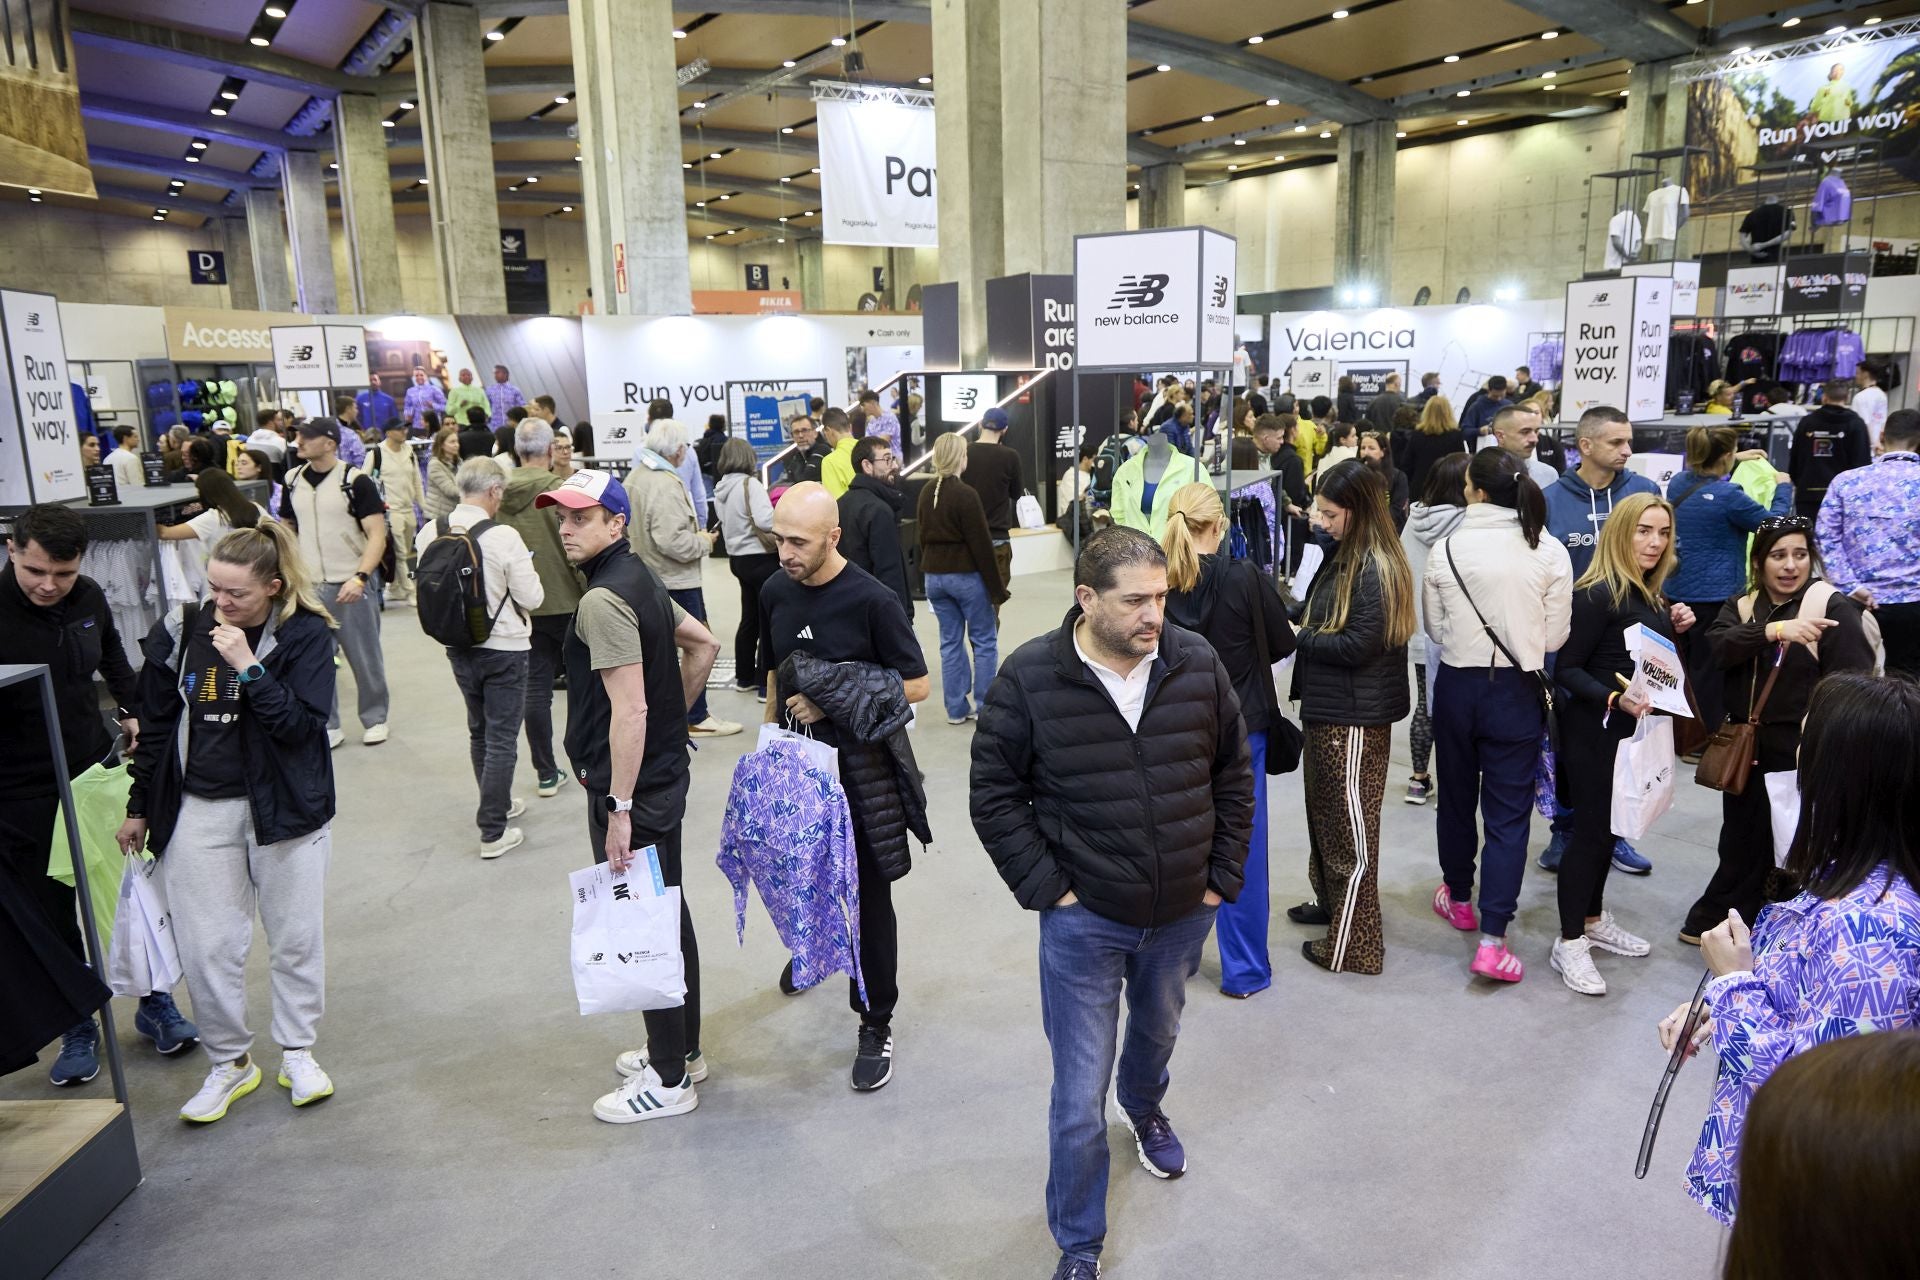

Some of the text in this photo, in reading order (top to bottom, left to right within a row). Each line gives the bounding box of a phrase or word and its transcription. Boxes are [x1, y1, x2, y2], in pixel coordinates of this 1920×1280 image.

[1759, 110, 1908, 146] Run your way.
[885, 156, 937, 197] Pa
[198, 253, 215, 270] D
[752, 266, 762, 280] B
[1095, 313, 1179, 327] new balance
[1641, 320, 1661, 337] Run
[877, 329, 910, 337] Cash only
[1286, 326, 1415, 351] Valencia
[1580, 323, 1615, 340] Run
[1046, 352, 1074, 371] no
[1576, 345, 1619, 364] your
[1638, 345, 1661, 362] your
[24, 355, 57, 380] Run
[1575, 366, 1617, 383] way.
[1637, 365, 1660, 381] way.
[1352, 374, 1370, 383] New
[624, 382, 669, 404] Run
[1360, 383, 1379, 392] 2026
[27, 391, 63, 416] your
[32, 420, 70, 444] way.
[1642, 660, 1678, 690] MARATHON
